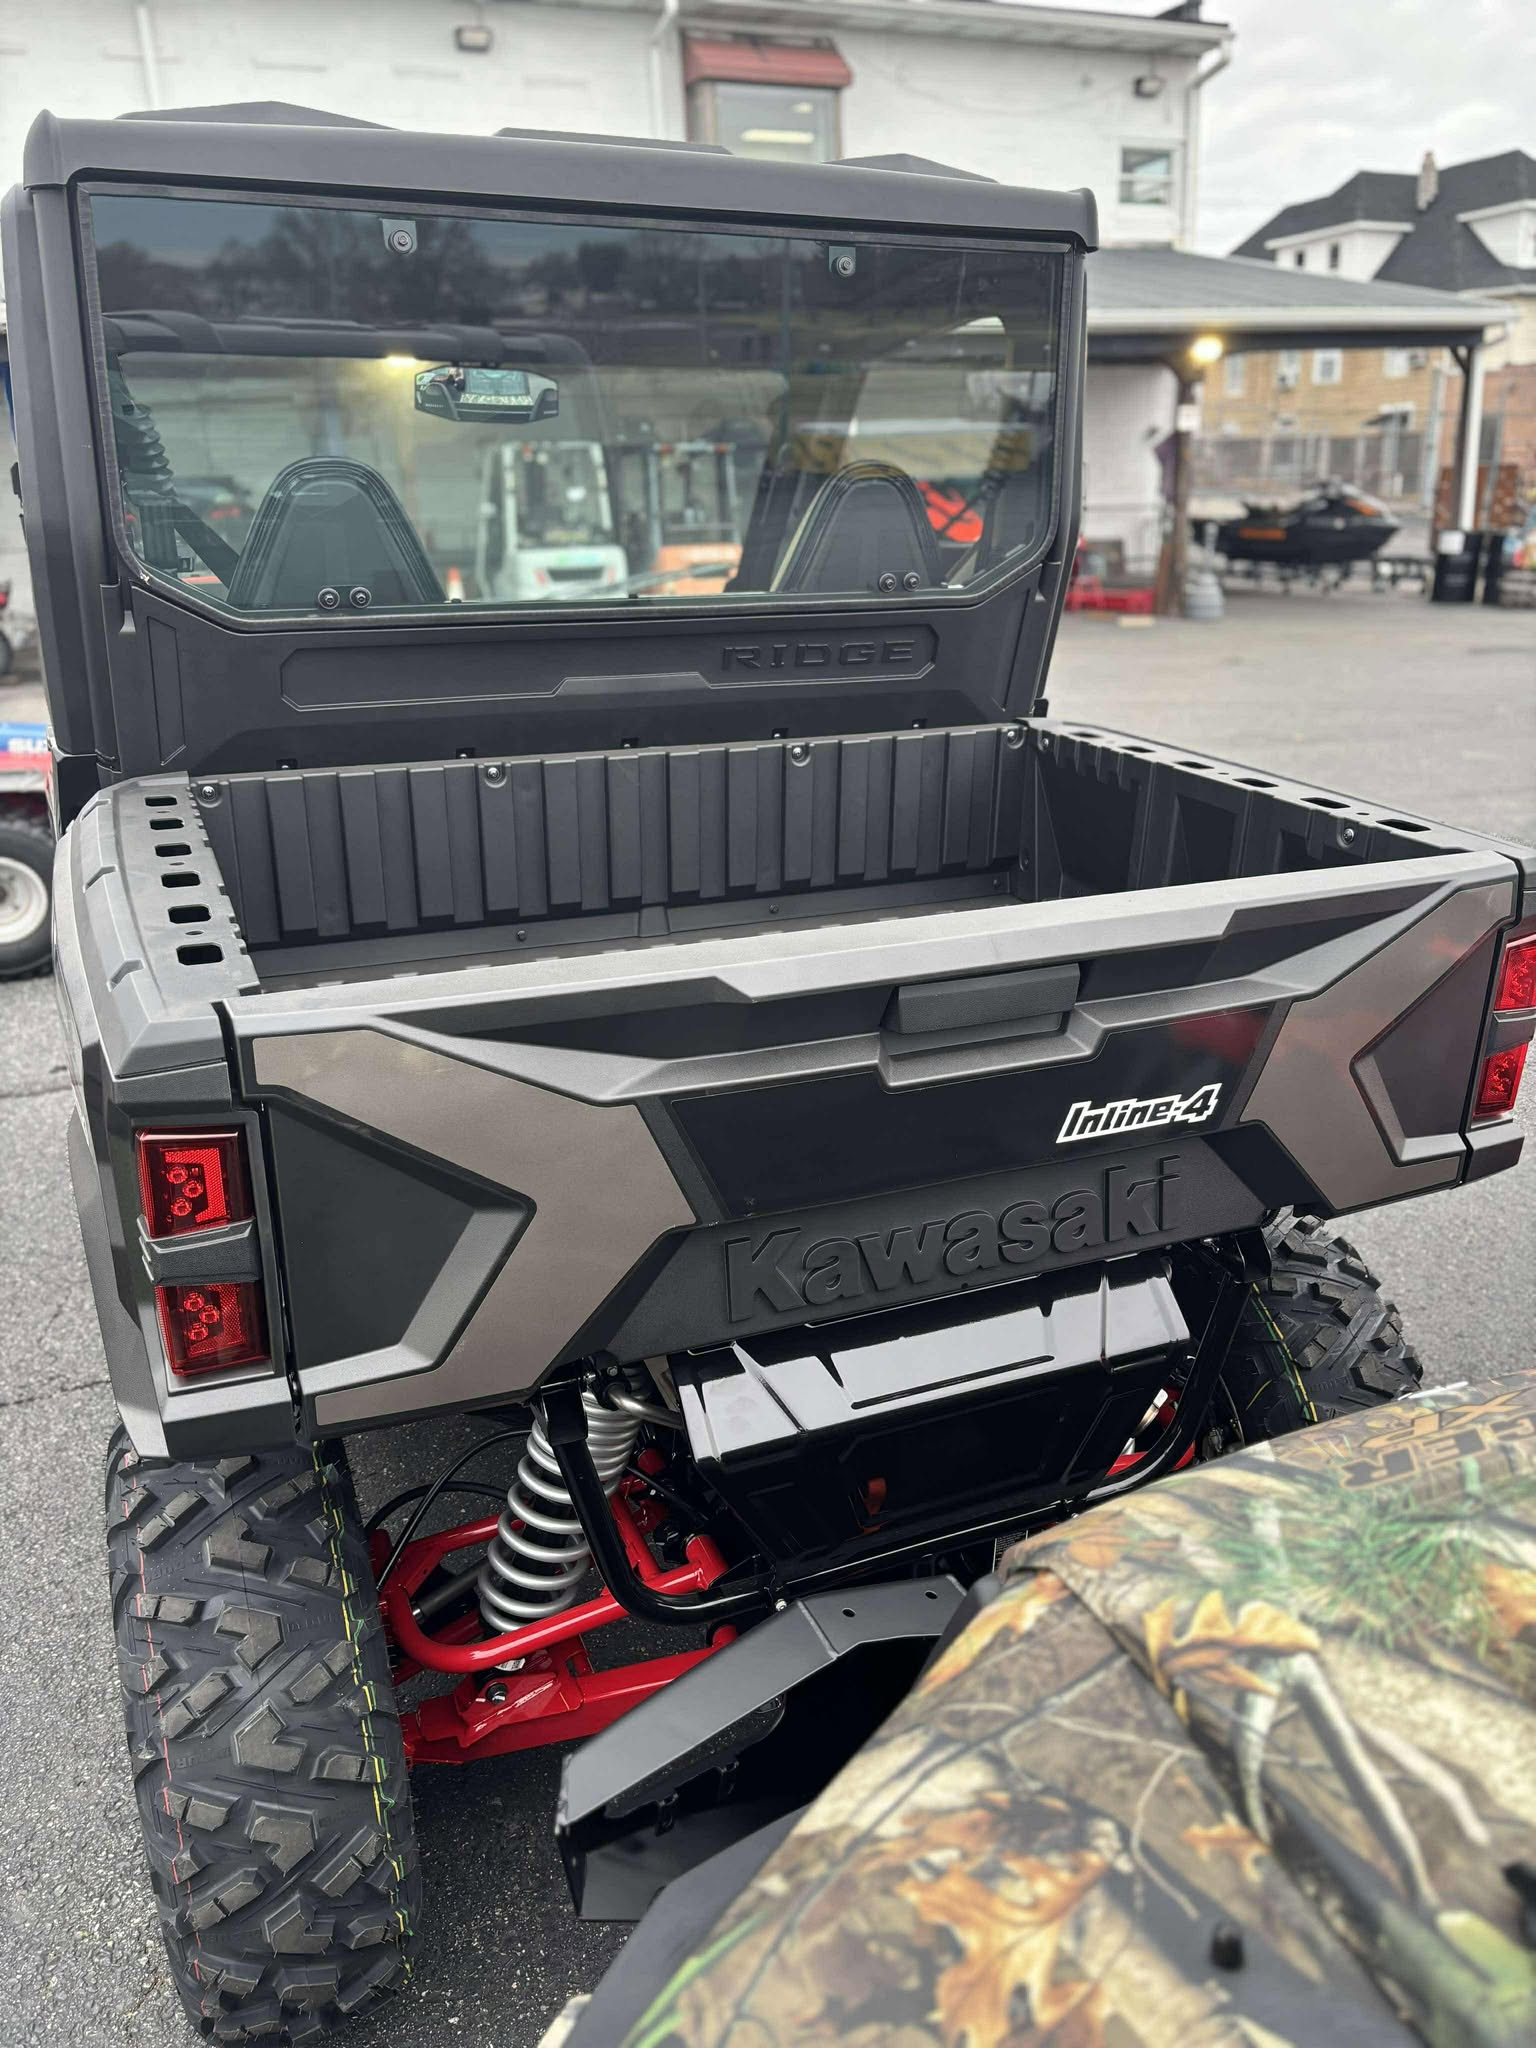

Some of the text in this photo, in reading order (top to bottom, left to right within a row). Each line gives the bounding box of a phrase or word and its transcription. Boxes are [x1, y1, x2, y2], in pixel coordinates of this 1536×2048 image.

[721, 639, 916, 671] RIDGE
[1056, 1083, 1222, 1143] Inline-4
[724, 1154, 1181, 1322] Kawasaki
